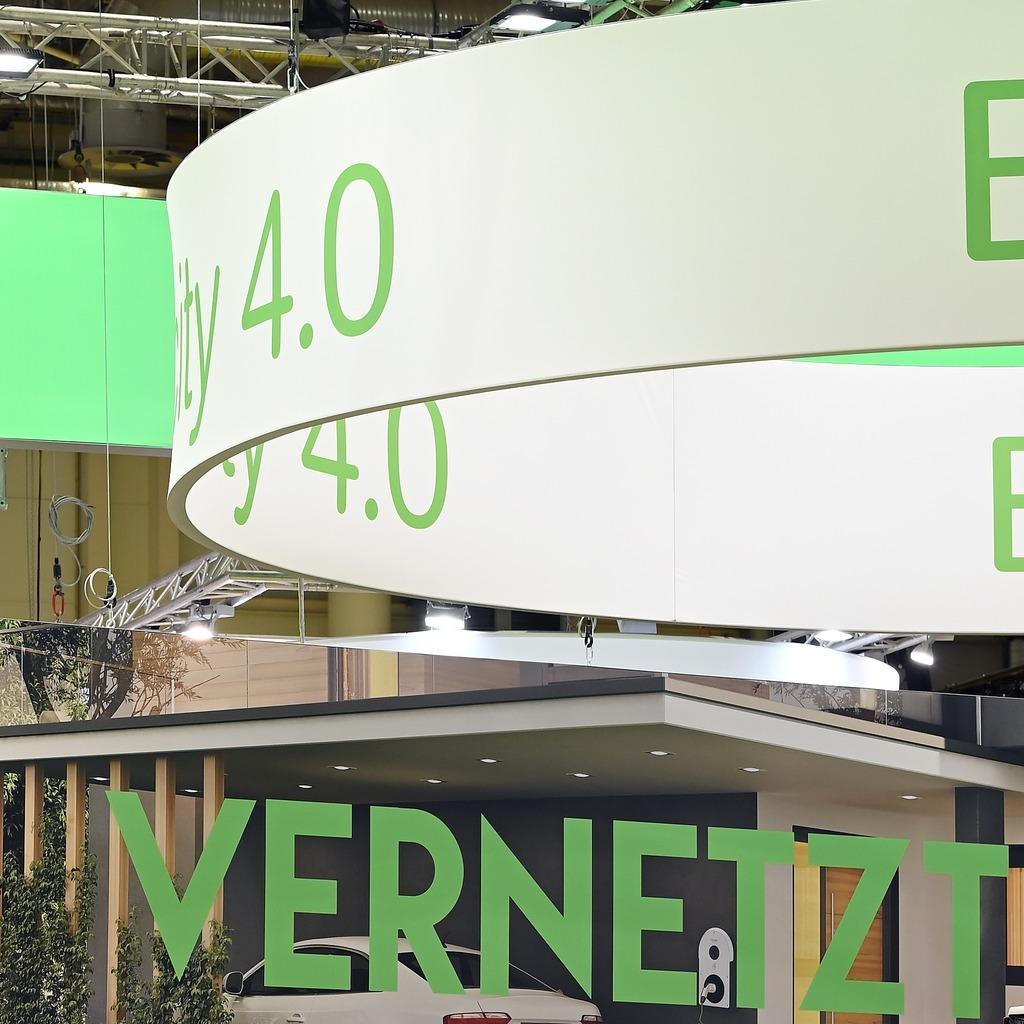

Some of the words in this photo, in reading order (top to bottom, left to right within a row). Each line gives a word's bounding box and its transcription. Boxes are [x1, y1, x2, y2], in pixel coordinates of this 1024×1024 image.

[176, 257, 220, 446] ity
[242, 163, 394, 359] 4.0
[302, 401, 448, 529] 4.0
[105, 790, 1009, 1019] VERNETZT
